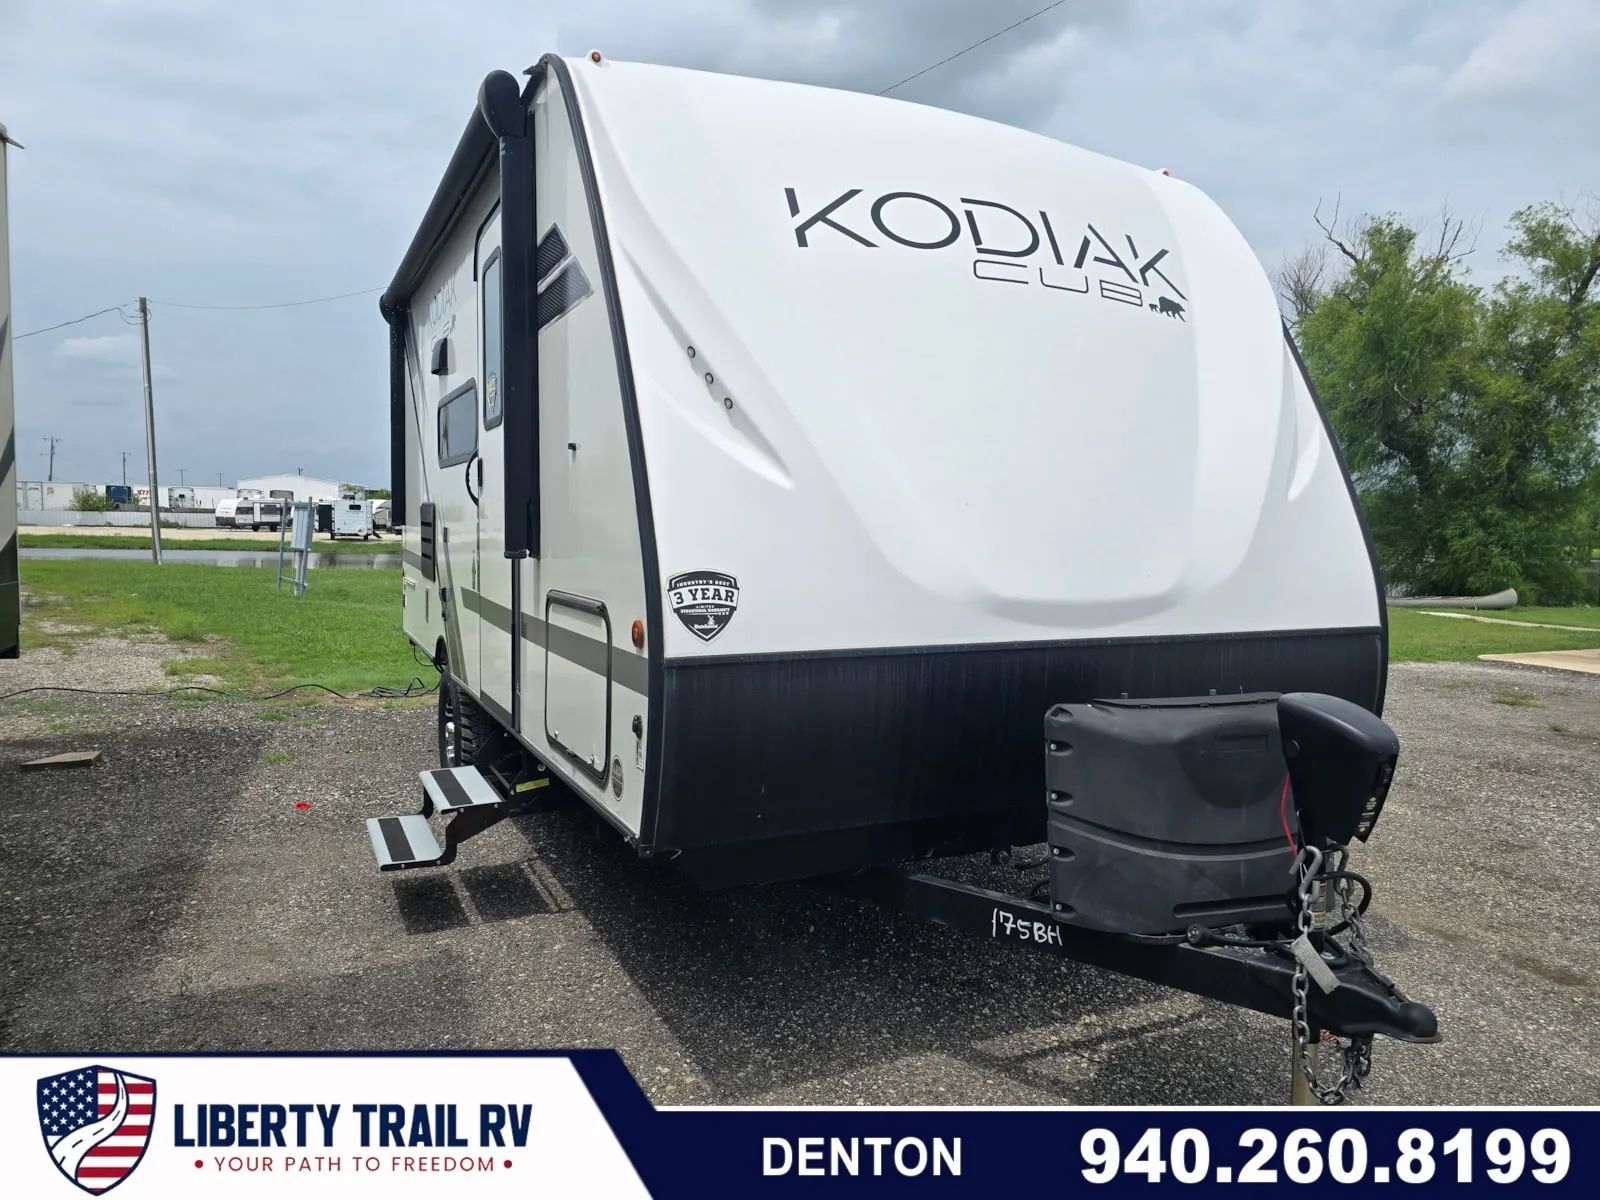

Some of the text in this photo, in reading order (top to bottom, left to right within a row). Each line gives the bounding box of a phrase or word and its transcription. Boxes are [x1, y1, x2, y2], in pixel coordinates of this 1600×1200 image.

[784, 187, 1187, 301] KODIAK
[973, 259, 1143, 307] CUB
[673, 588, 734, 605] 3 YEAR
[991, 908, 1063, 946] 175BH
